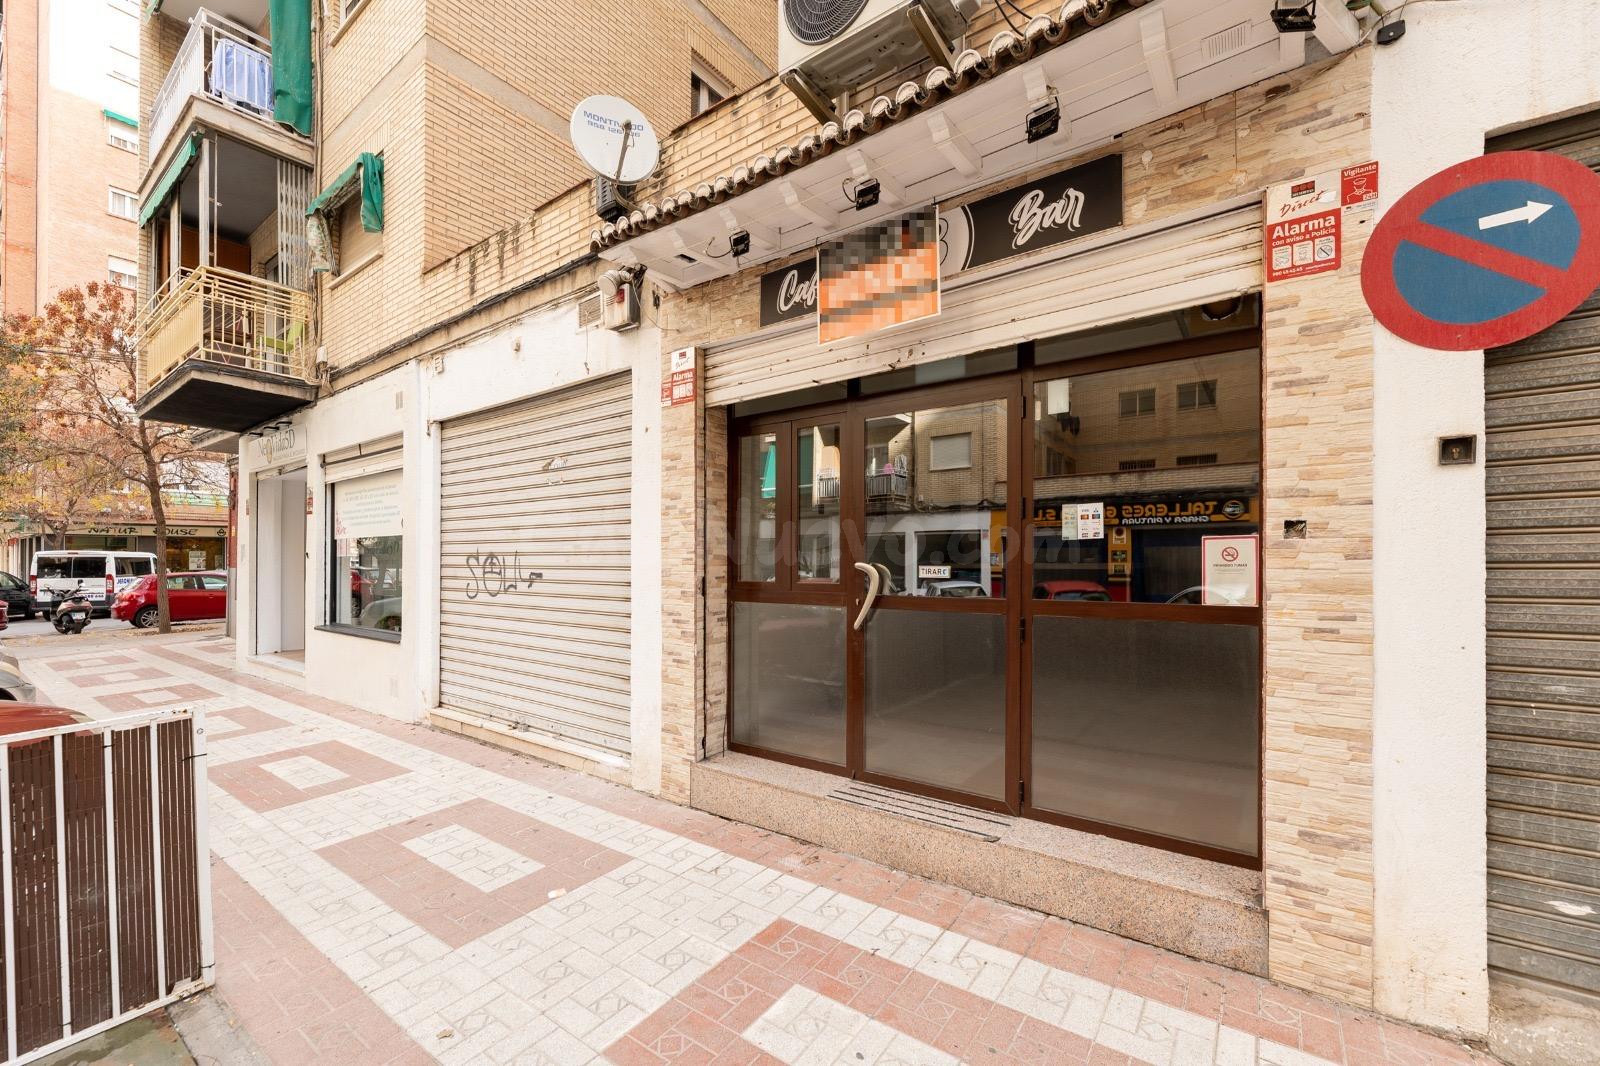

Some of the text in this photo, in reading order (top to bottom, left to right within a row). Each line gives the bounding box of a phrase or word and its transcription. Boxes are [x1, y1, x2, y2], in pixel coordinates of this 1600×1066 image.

[1343, 164, 1377, 177] Vigilante
[1280, 190, 1325, 217] Direct
[1008, 187, 1085, 249] Bar
[1272, 215, 1336, 240] Alarma
[1272, 239, 1285, 247] con
[1285, 234, 1305, 244] aviso
[777, 269, 818, 315] Caf
[152, 527, 199, 536] OUSE
[921, 568, 942, 576] TIRAR
